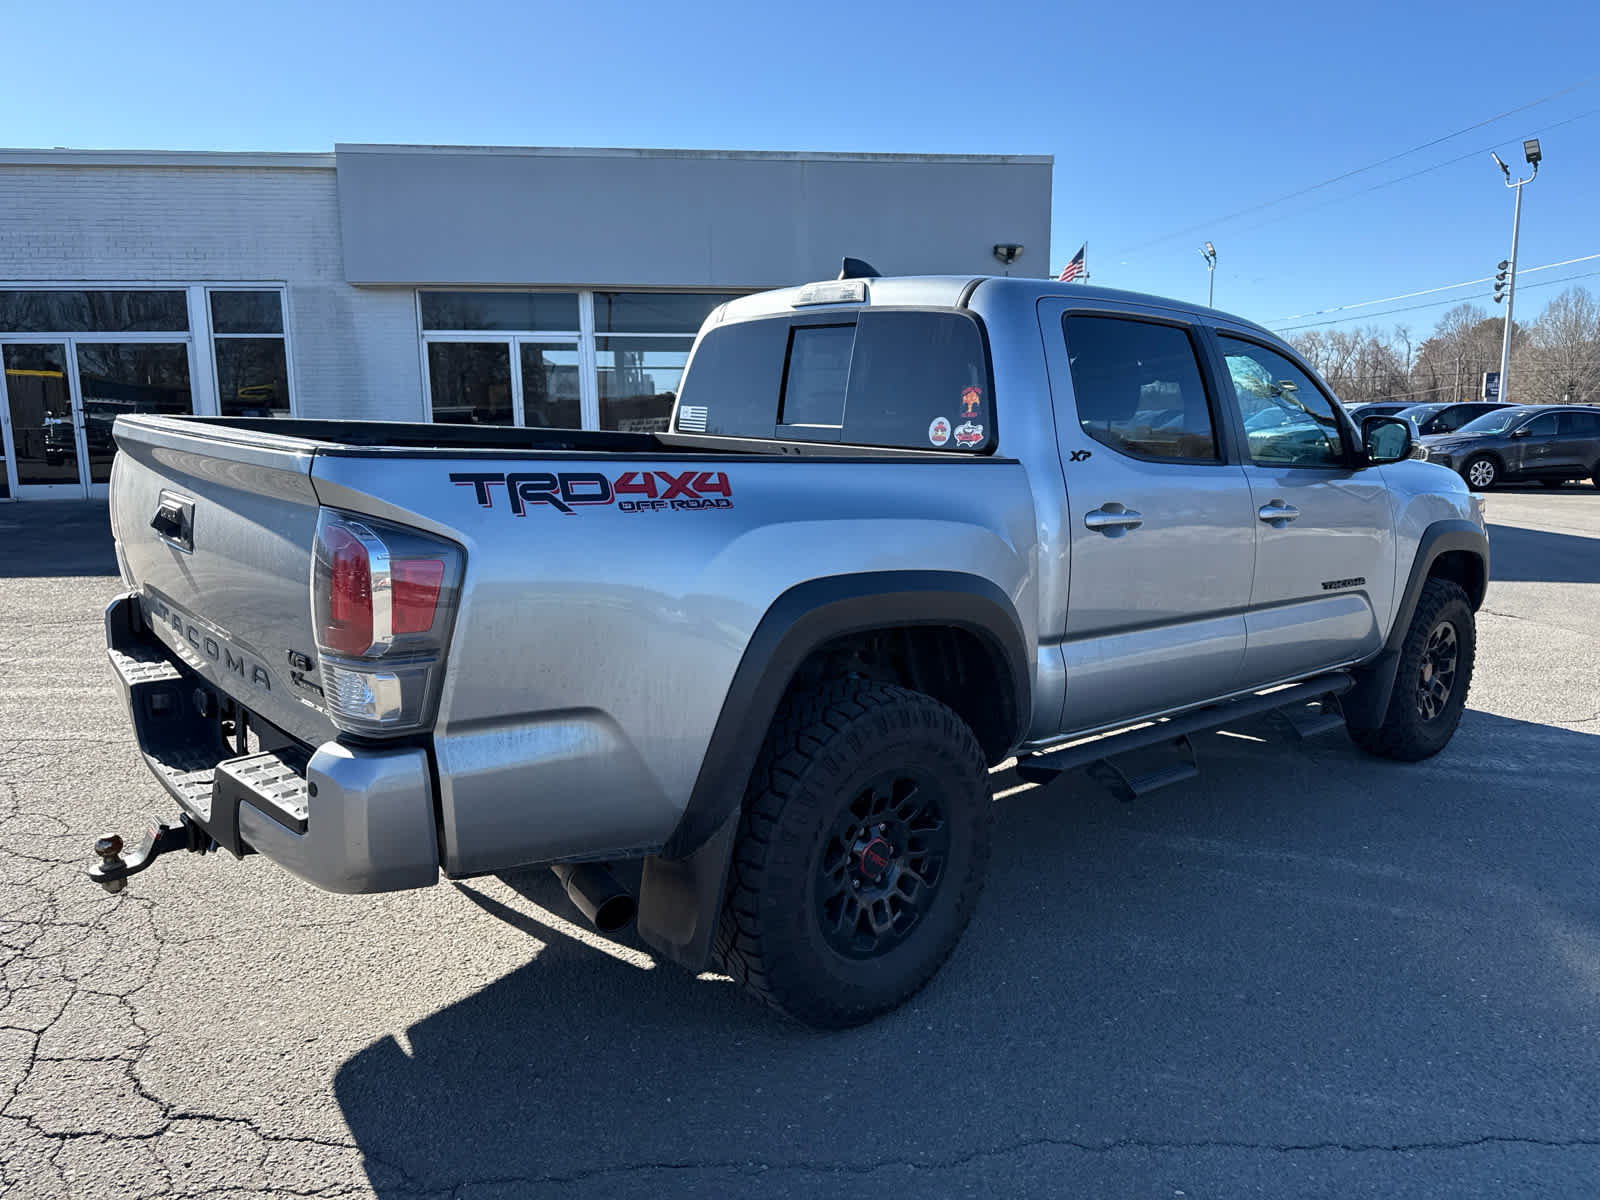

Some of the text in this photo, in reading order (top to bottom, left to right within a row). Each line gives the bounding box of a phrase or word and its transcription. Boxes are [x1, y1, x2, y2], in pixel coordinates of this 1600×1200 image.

[1069, 450, 1092, 462] XP
[449, 472, 616, 517] TRD
[618, 498, 733, 513] OFF ROAD
[1321, 577, 1366, 590] TACOMA
[157, 599, 271, 692] TACOMA
